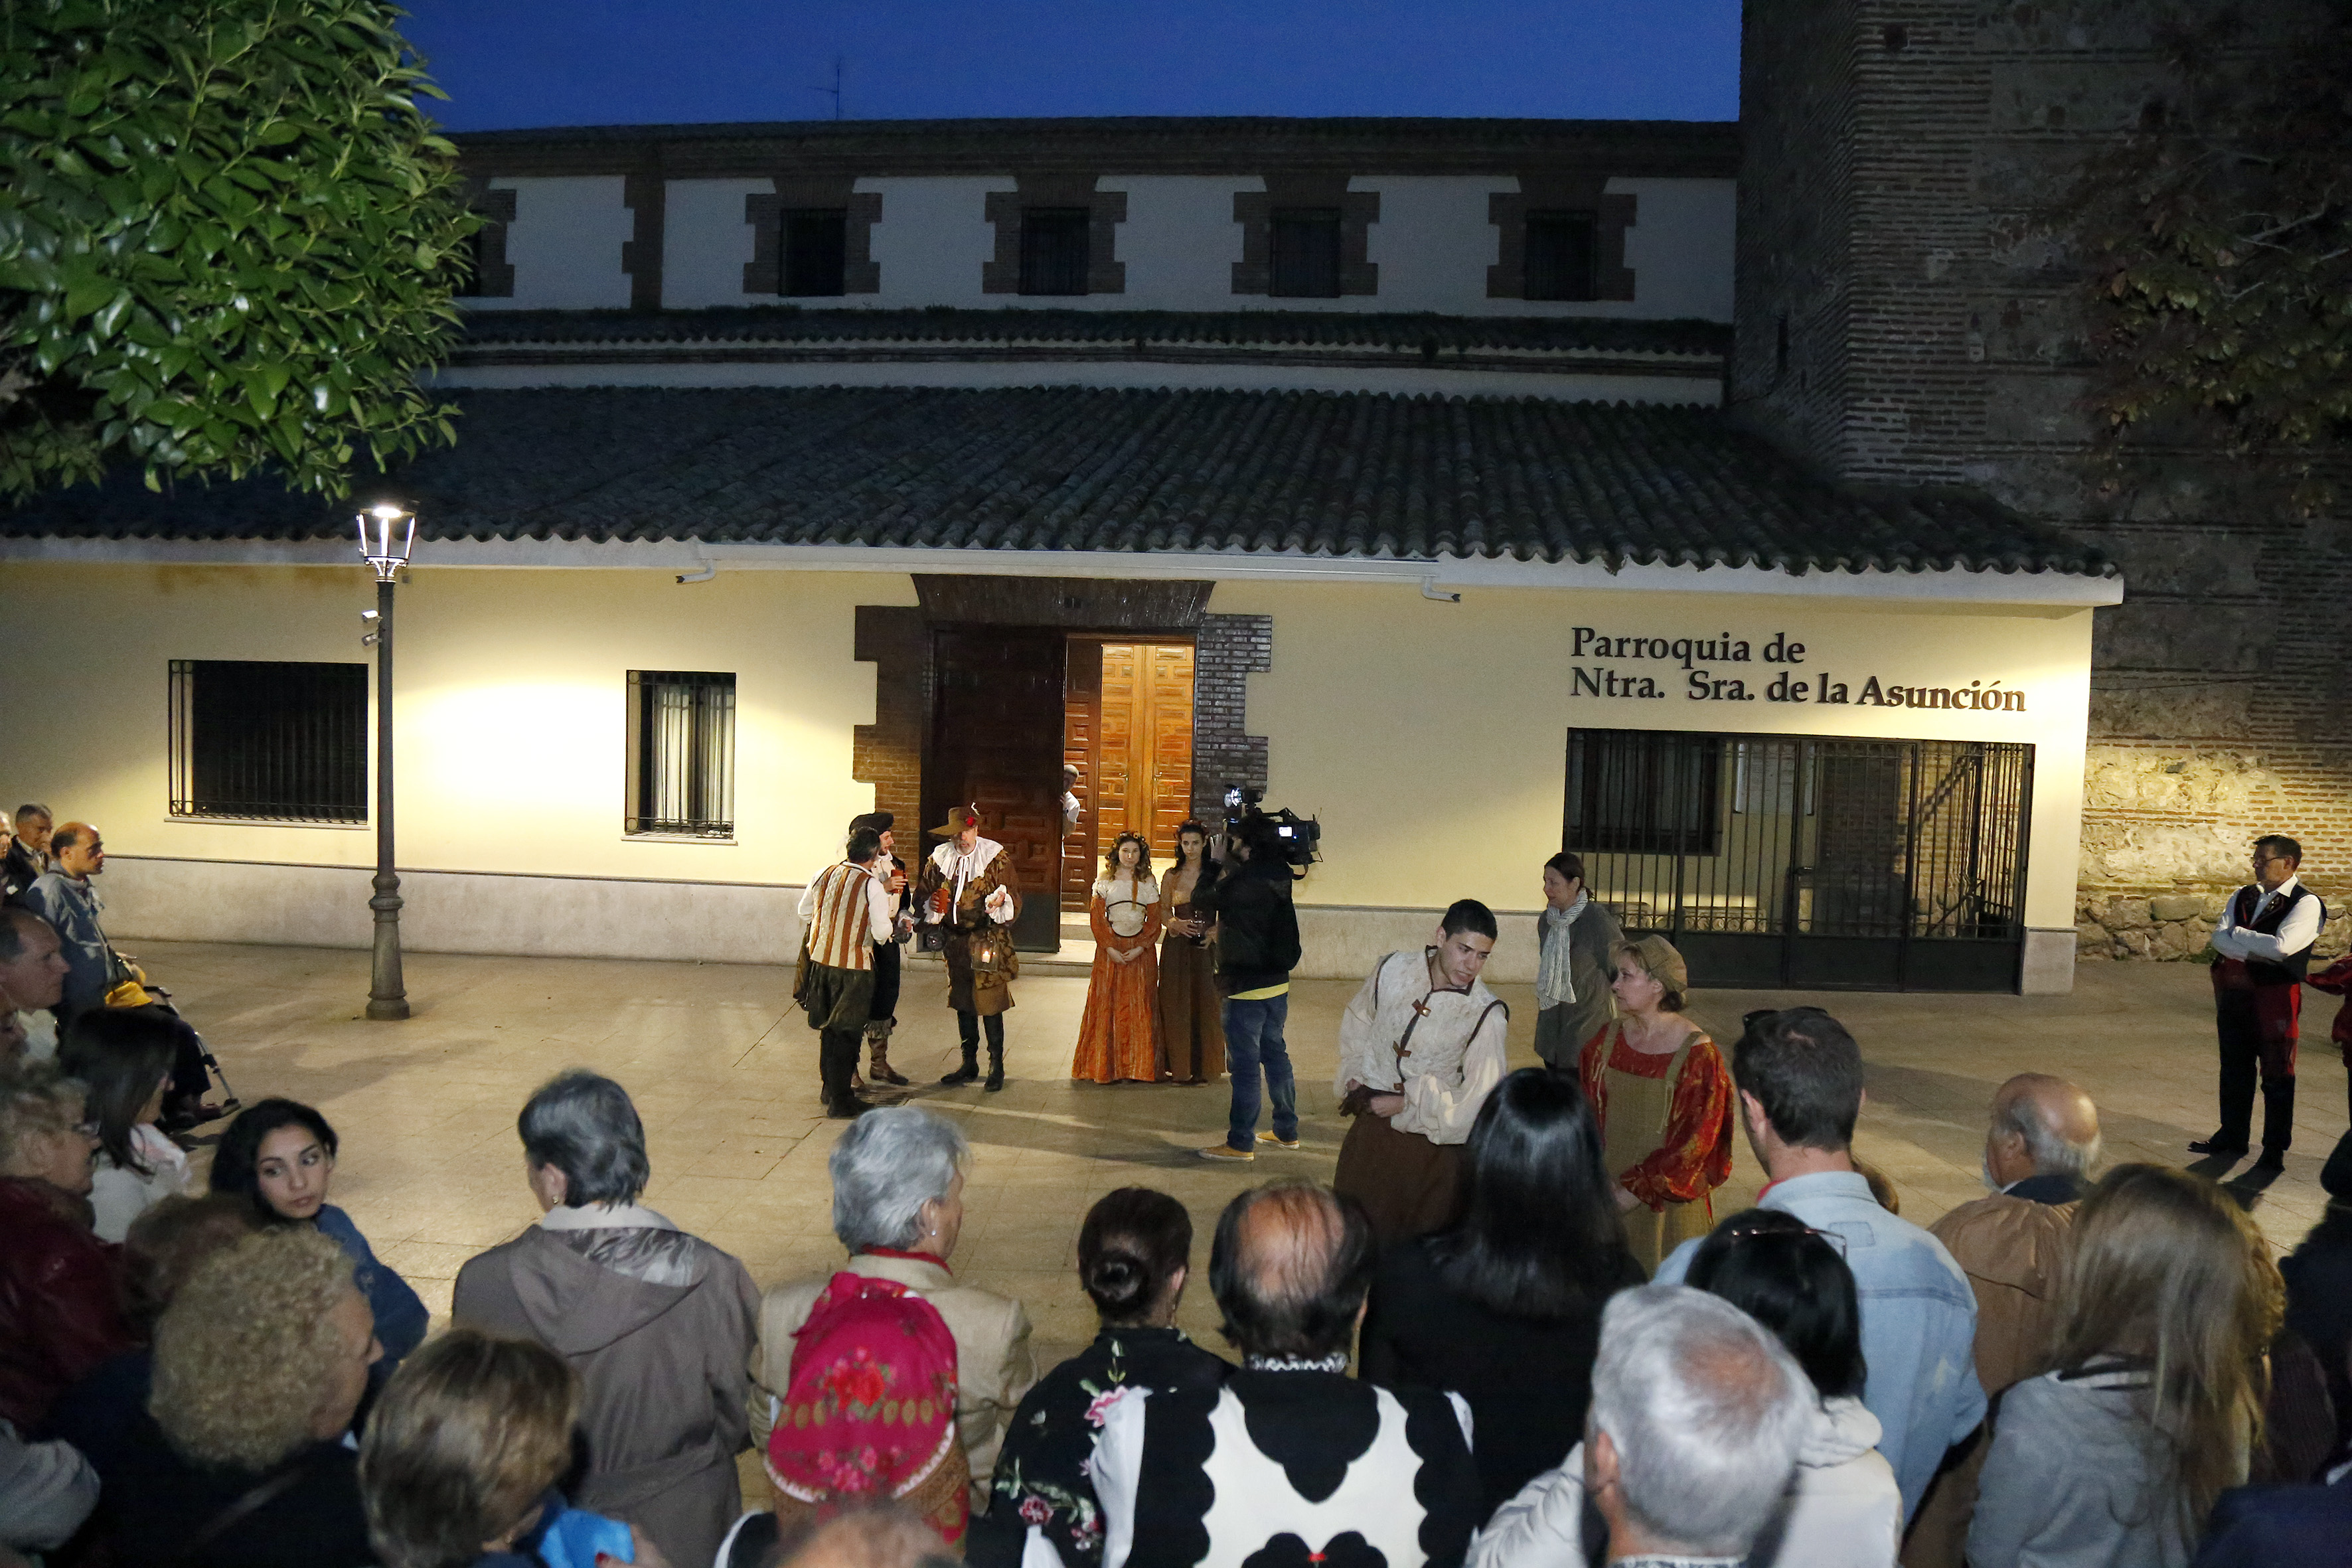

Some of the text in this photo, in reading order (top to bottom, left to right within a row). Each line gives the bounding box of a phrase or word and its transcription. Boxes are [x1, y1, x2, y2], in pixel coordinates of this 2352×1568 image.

[1571, 627, 1806, 670] Parroquia de
[1571, 666, 2027, 712] Ntra. Sra. de la Asunción
